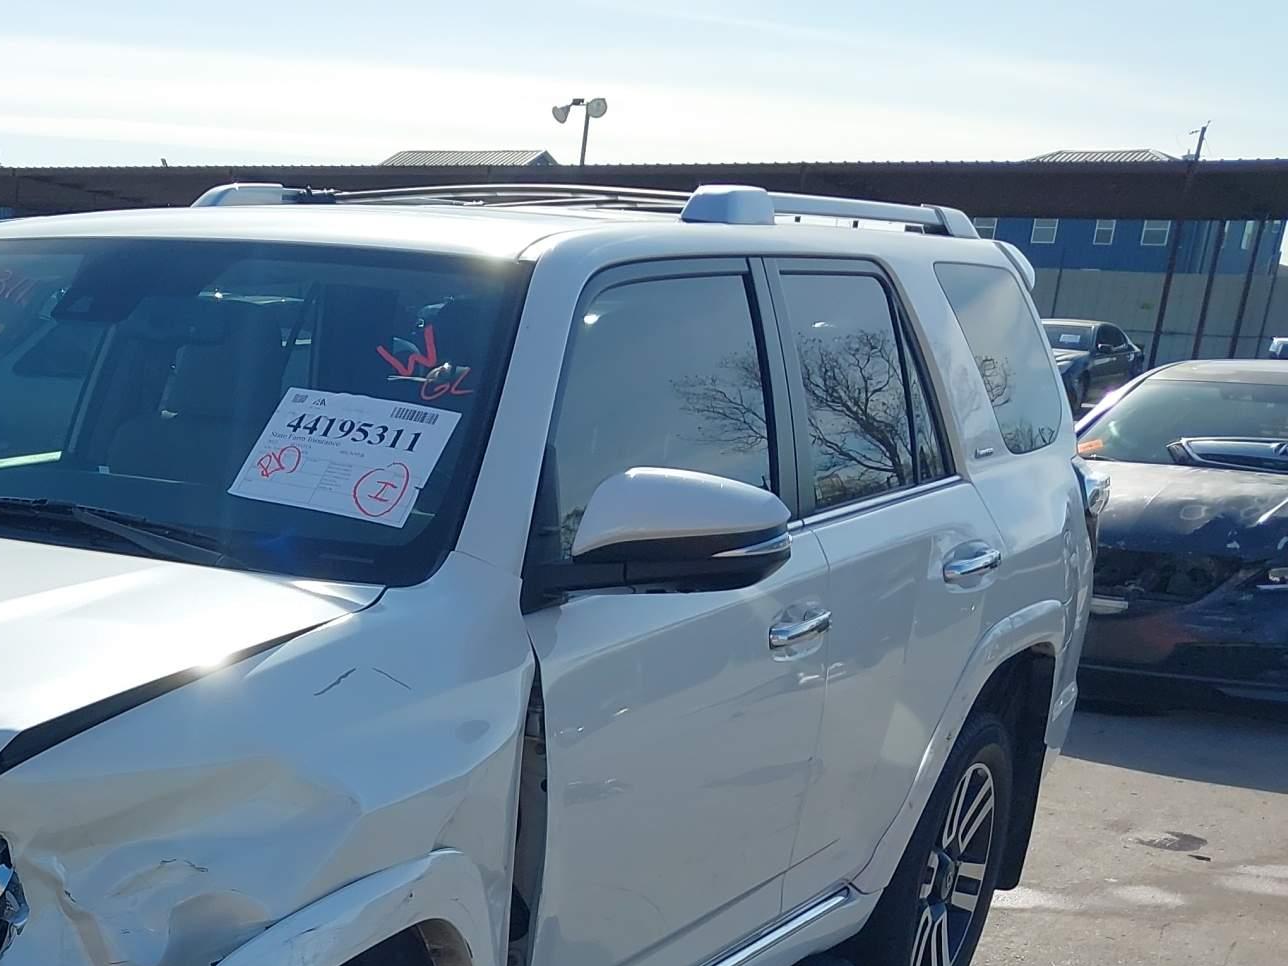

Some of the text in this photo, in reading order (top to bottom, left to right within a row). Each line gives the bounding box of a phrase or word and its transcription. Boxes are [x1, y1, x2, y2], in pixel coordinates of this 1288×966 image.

[376, 323, 437, 376] W
[271, 431, 288, 439] State
[288, 433, 306, 441] Farm
[286, 413, 423, 453] 44195311
